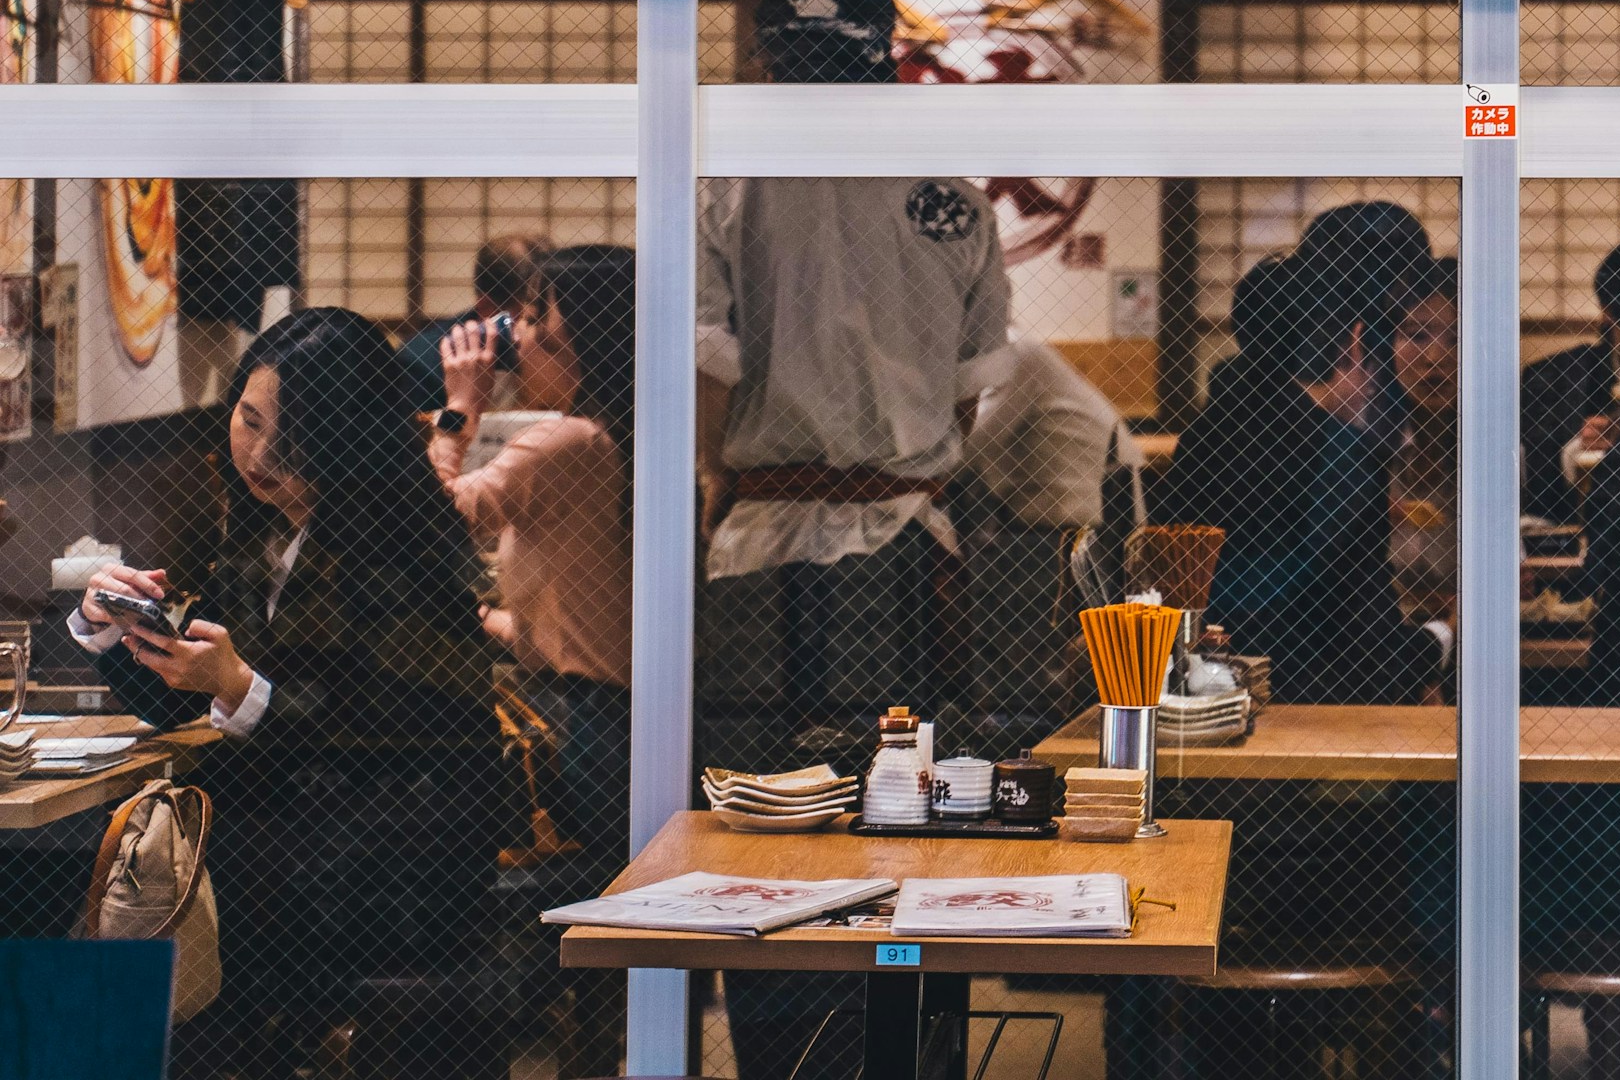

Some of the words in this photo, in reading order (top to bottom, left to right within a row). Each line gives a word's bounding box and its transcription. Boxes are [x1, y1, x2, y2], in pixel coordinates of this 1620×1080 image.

[1471, 107, 1509, 120] カメラ
[1471, 122, 1509, 135] 作動中
[887, 948, 907, 961] 91
